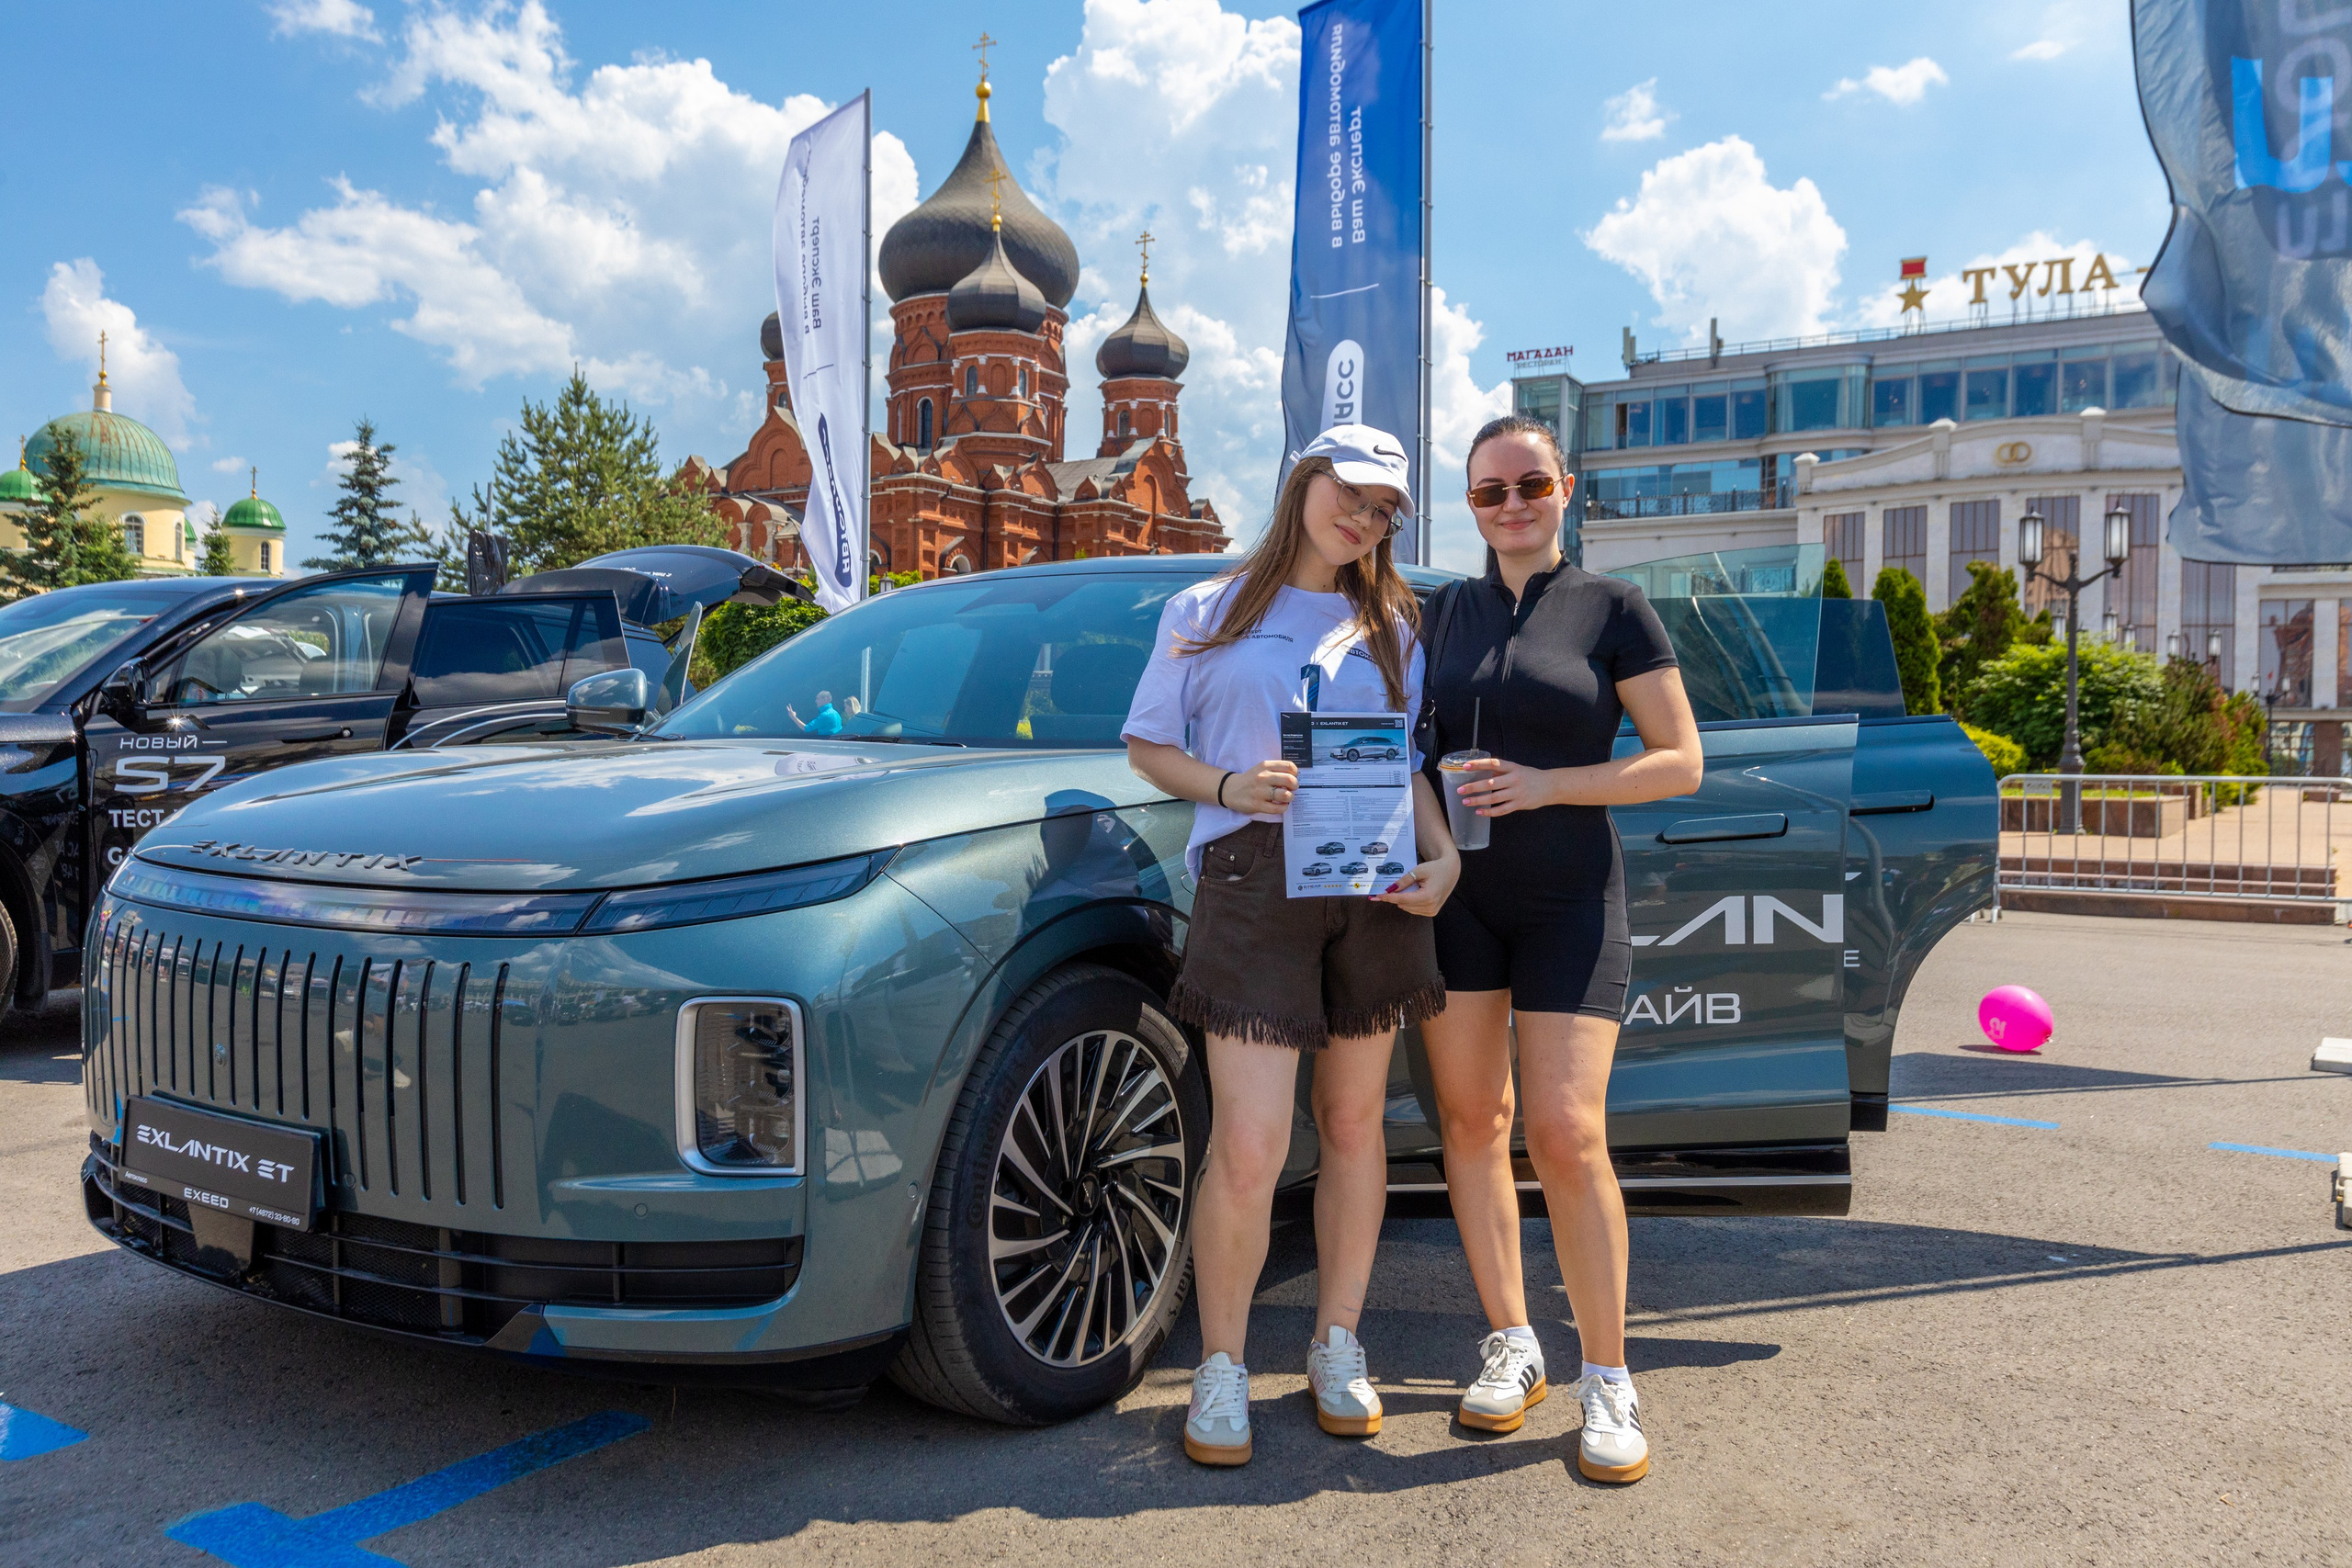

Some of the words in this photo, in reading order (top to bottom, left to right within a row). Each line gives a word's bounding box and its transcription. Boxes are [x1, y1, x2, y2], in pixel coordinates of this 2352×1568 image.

[1962, 252, 2120, 305] ТУЛА
[1507, 344, 1574, 363] МАГАДАН
[1251, 634, 1294, 643] АВТОМОБИЛЯ
[119, 734, 198, 750] НОВЫЙ
[114, 755, 226, 794] S7
[107, 808, 164, 828] ТЕСТ
[189, 840, 423, 872] EXLANTIX
[1623, 986, 1742, 1025] АЙВ
[137, 1123, 251, 1173] EXLANTIX
[257, 1158, 295, 1184] ET
[184, 1187, 230, 1209] EXEED
